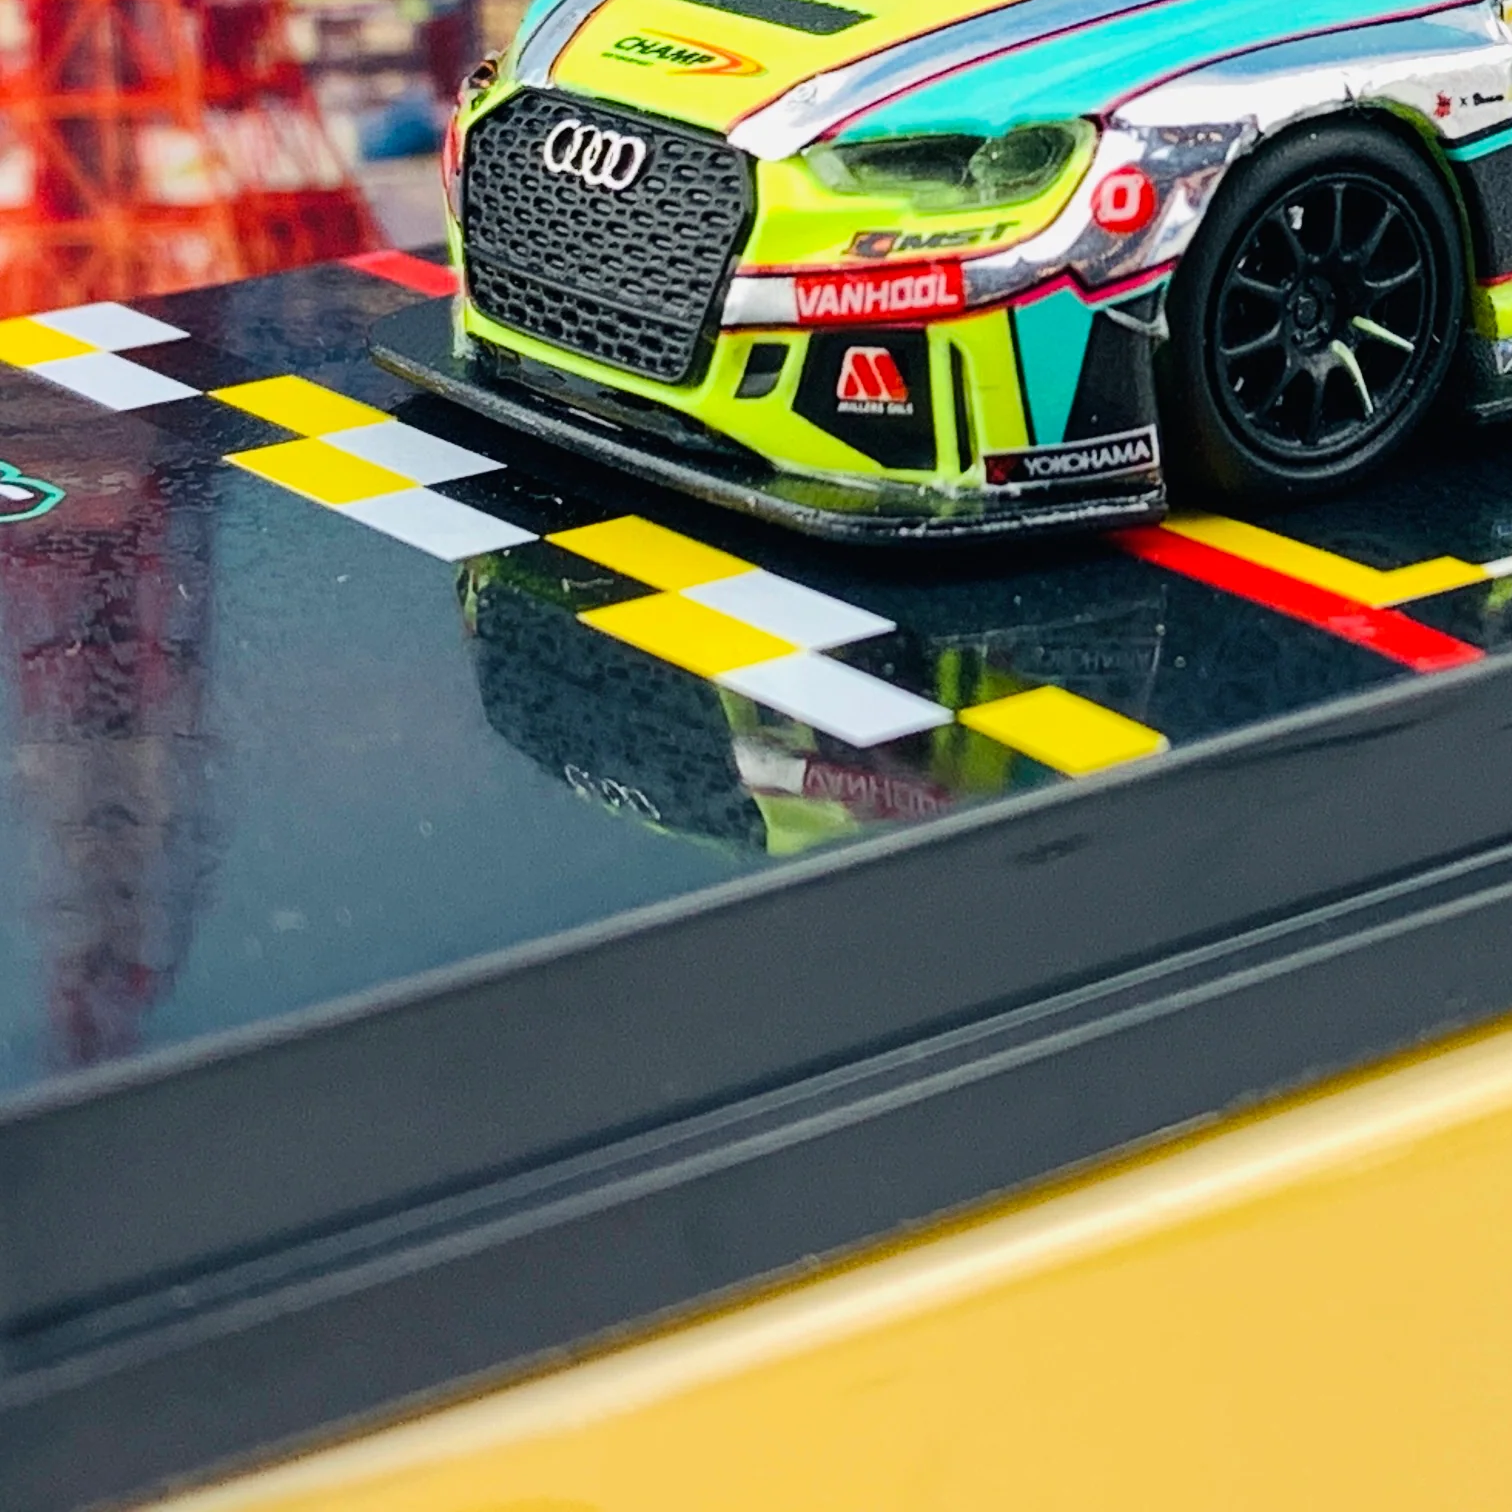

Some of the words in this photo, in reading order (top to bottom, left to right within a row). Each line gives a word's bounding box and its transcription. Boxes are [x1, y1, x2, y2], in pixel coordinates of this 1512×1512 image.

[614, 35, 717, 67] CHAMP
[800, 272, 959, 317] VANHOOL
[1022, 439, 1151, 477] YOKOHAMA
